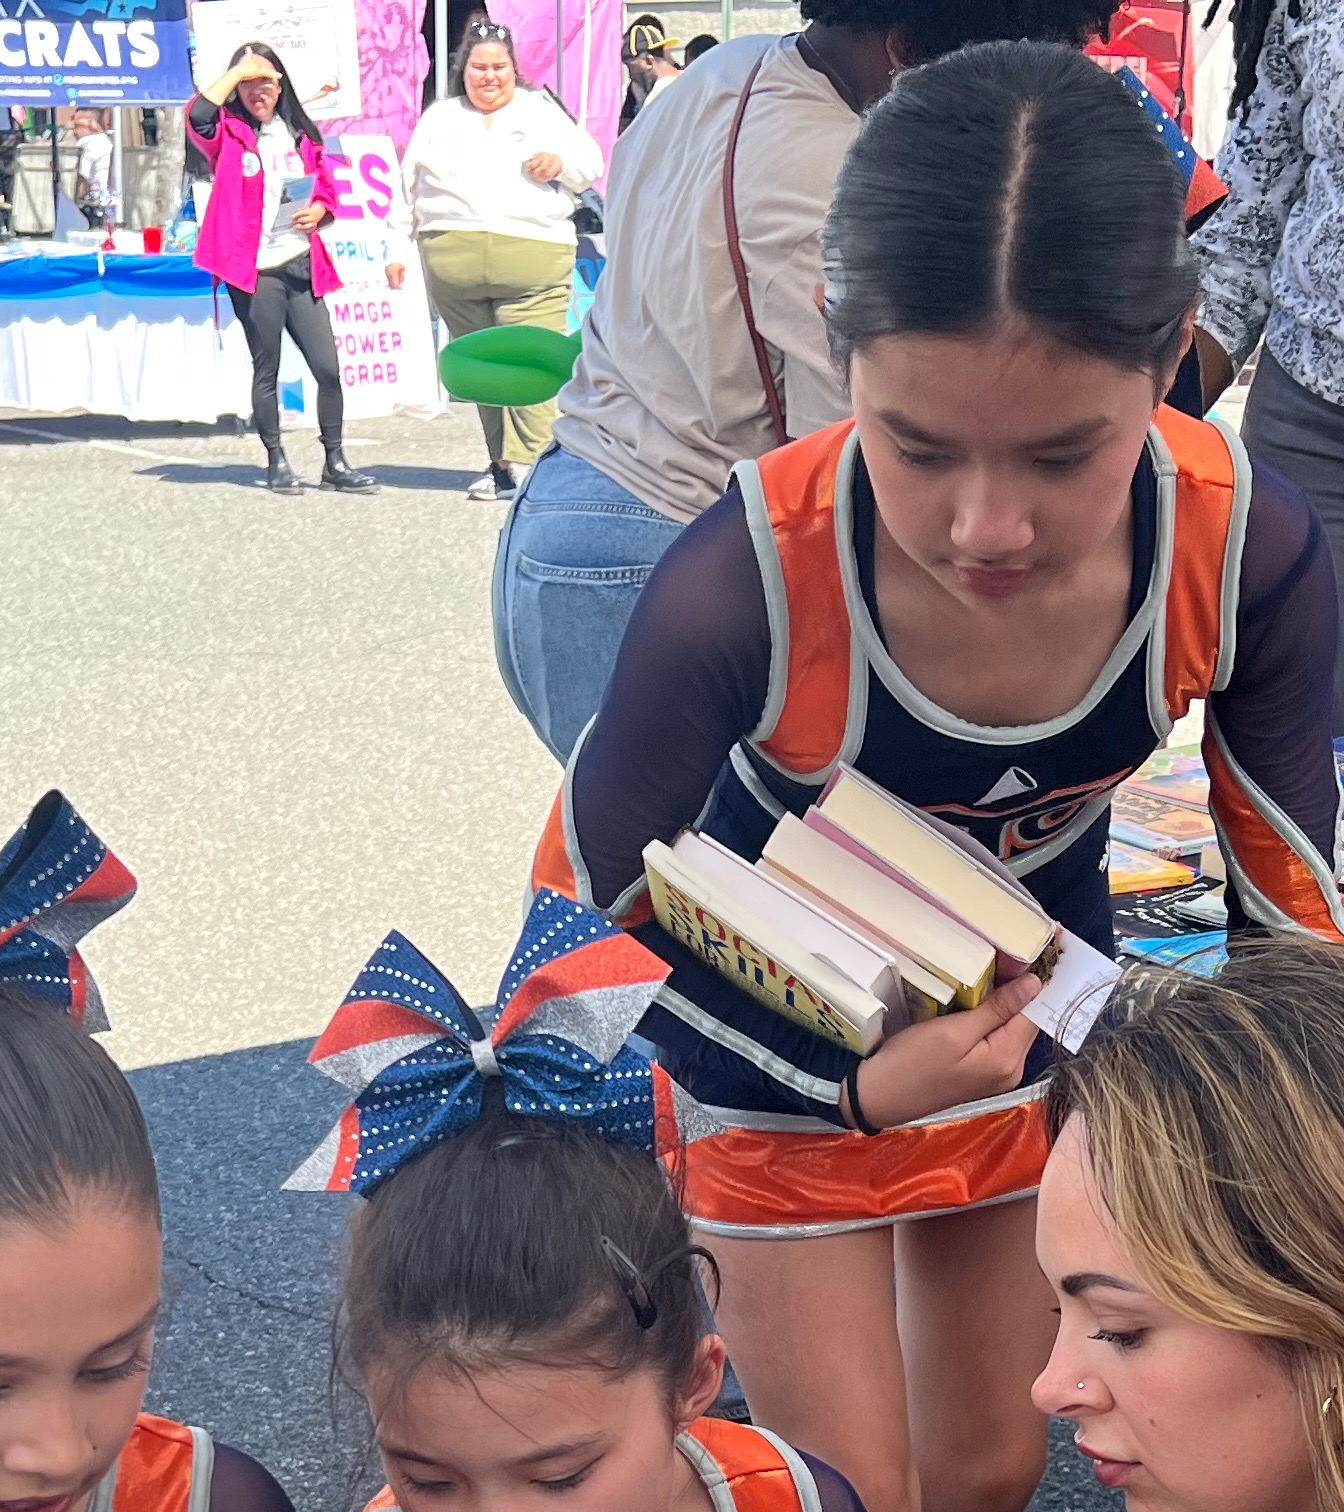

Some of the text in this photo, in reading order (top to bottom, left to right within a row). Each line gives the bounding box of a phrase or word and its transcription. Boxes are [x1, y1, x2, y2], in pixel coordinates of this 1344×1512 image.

[332, 153, 394, 220] ES
[335, 301, 393, 325] MAGA
[345, 362, 399, 387] GRAB
